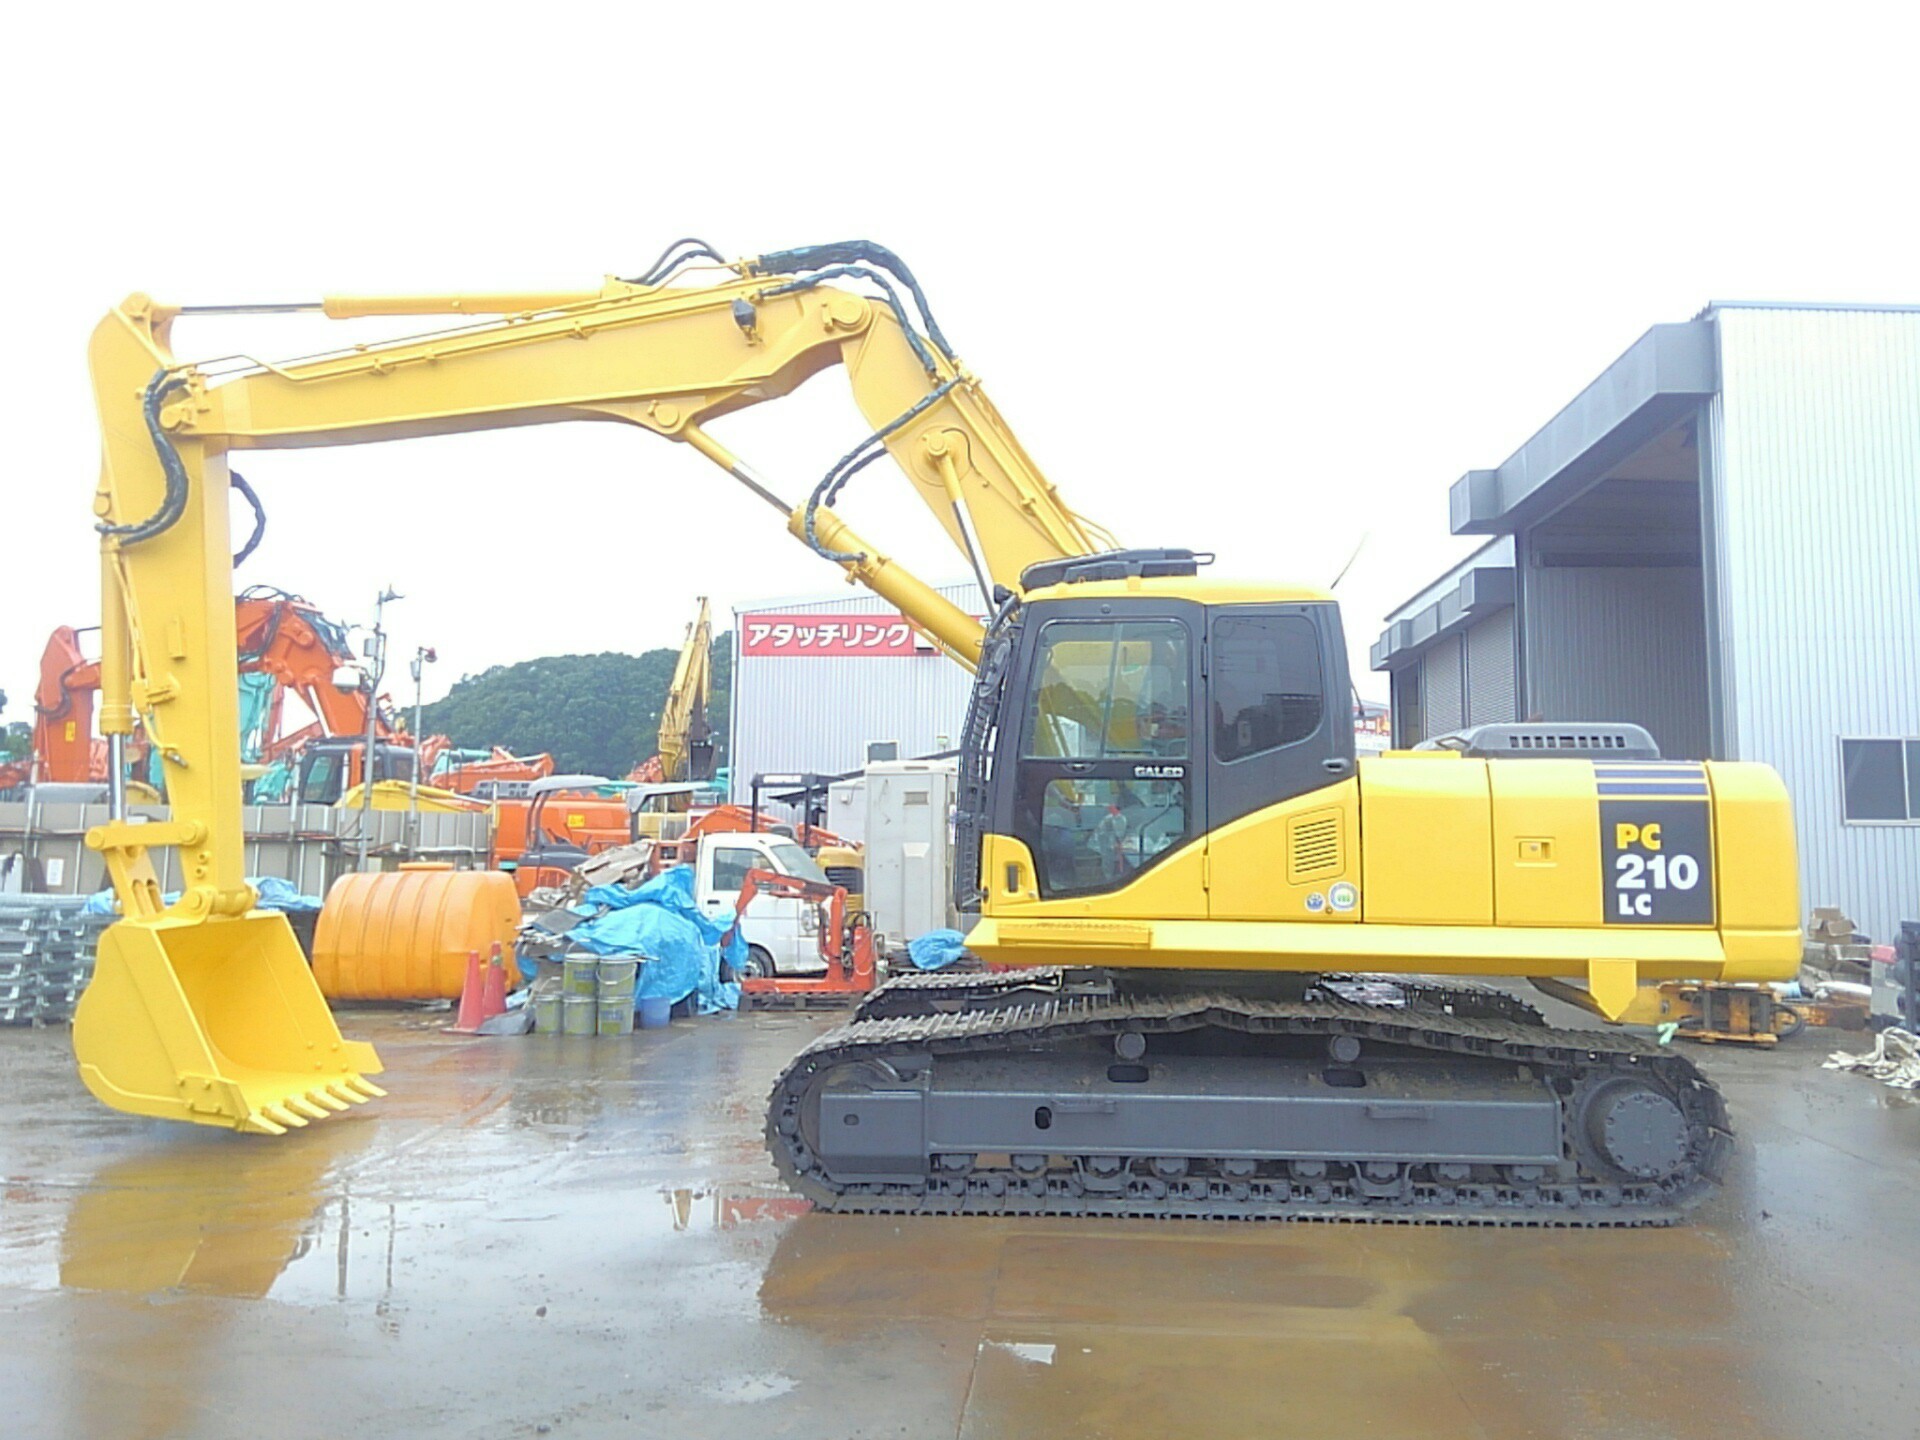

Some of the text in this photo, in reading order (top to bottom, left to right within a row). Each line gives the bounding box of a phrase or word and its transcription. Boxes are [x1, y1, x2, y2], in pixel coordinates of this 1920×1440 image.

[747, 623, 910, 648] アタッチリンク
[1615, 823, 1662, 850] PC
[1615, 853, 1700, 890] 210
[1619, 892, 1652, 916] LC
